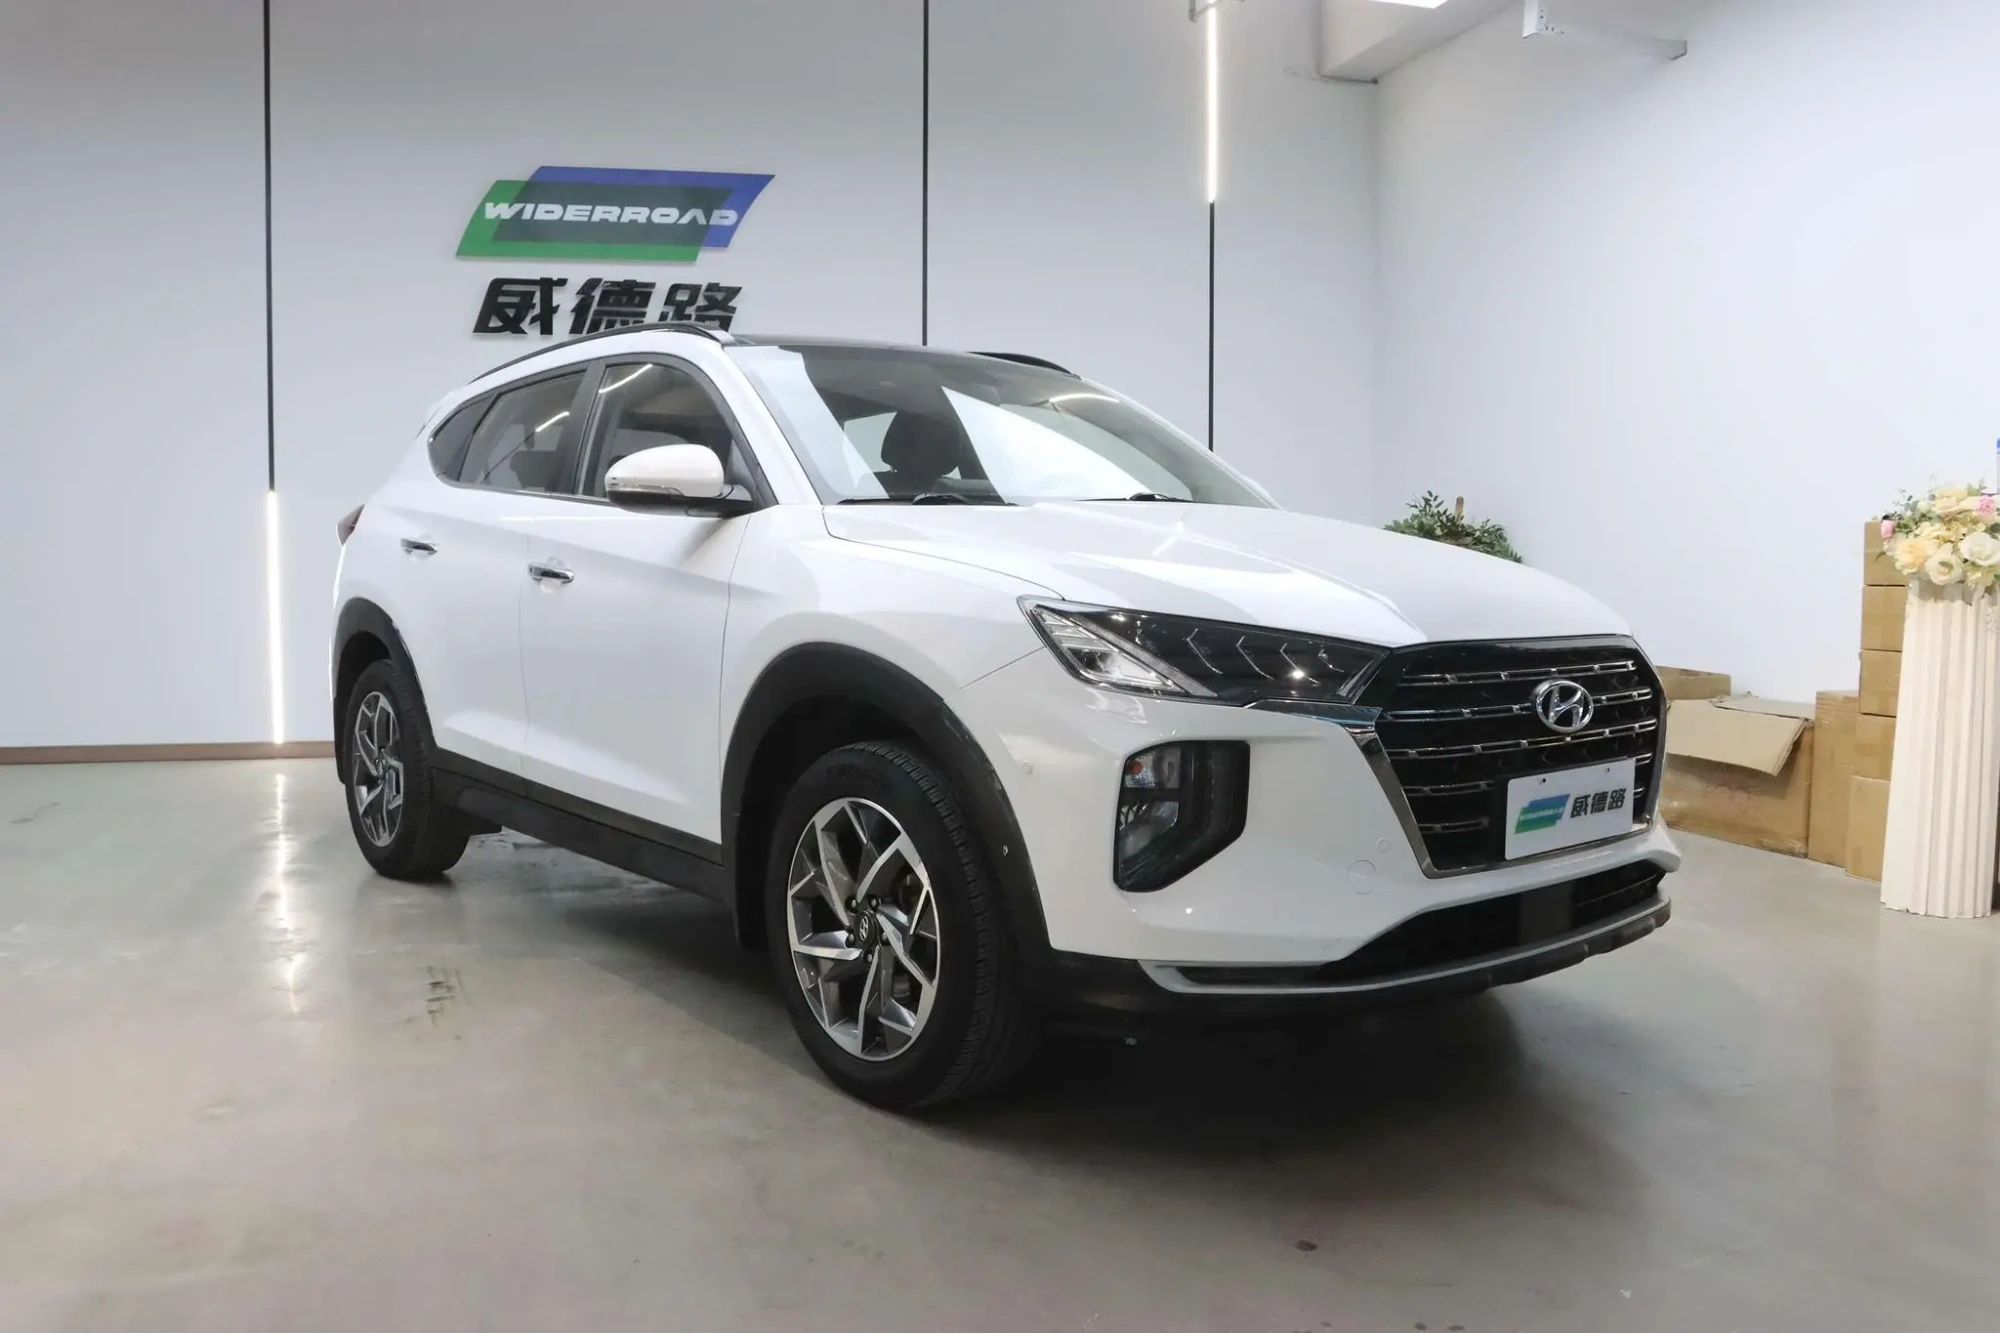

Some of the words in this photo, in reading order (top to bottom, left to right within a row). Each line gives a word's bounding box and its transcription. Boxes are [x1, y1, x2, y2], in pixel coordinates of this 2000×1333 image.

[484, 203, 738, 226] WIDERROAD
[473, 277, 742, 335] 威德路
[1570, 788, 1626, 818] 威德路
